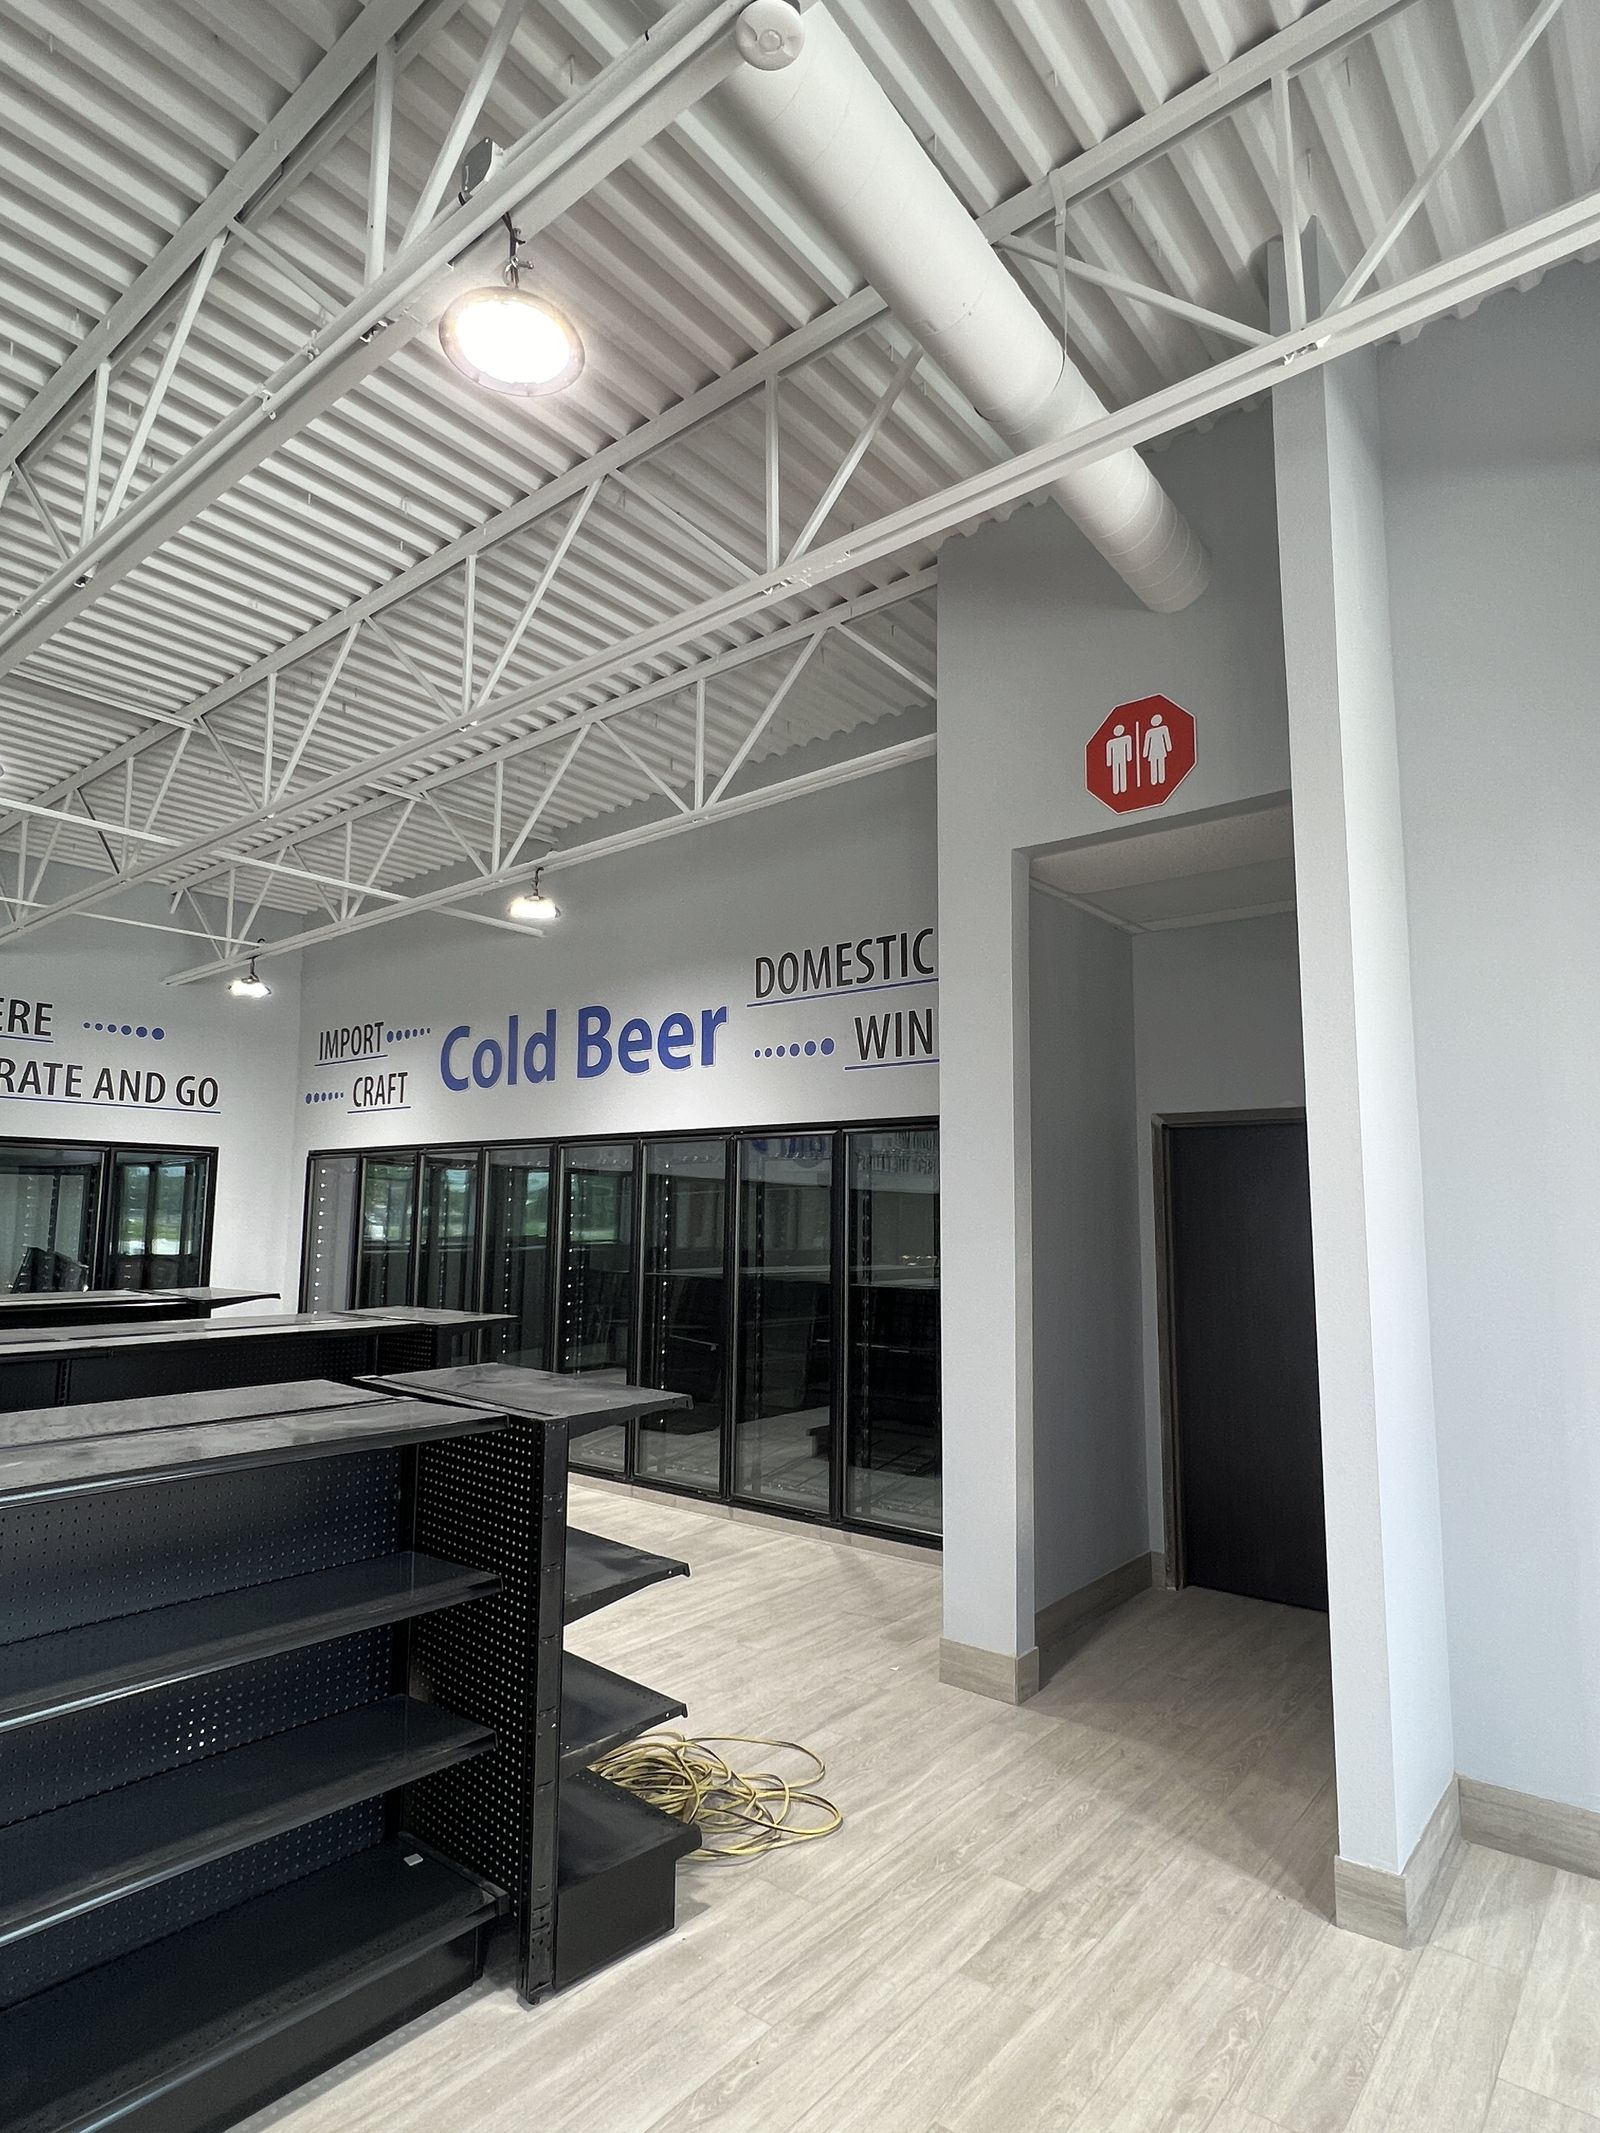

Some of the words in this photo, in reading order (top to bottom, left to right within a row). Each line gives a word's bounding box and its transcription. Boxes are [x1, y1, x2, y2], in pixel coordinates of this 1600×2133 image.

[755, 928, 934, 998] DOMESTIC
[319, 1021, 384, 1060] IMPORT
[440, 1008, 557, 1092] Cold
[576, 1004, 727, 1075] Beer
[92, 1067, 165, 1103] AND
[175, 1075, 219, 1107] GO
[352, 1072, 408, 1107] CRAFT
